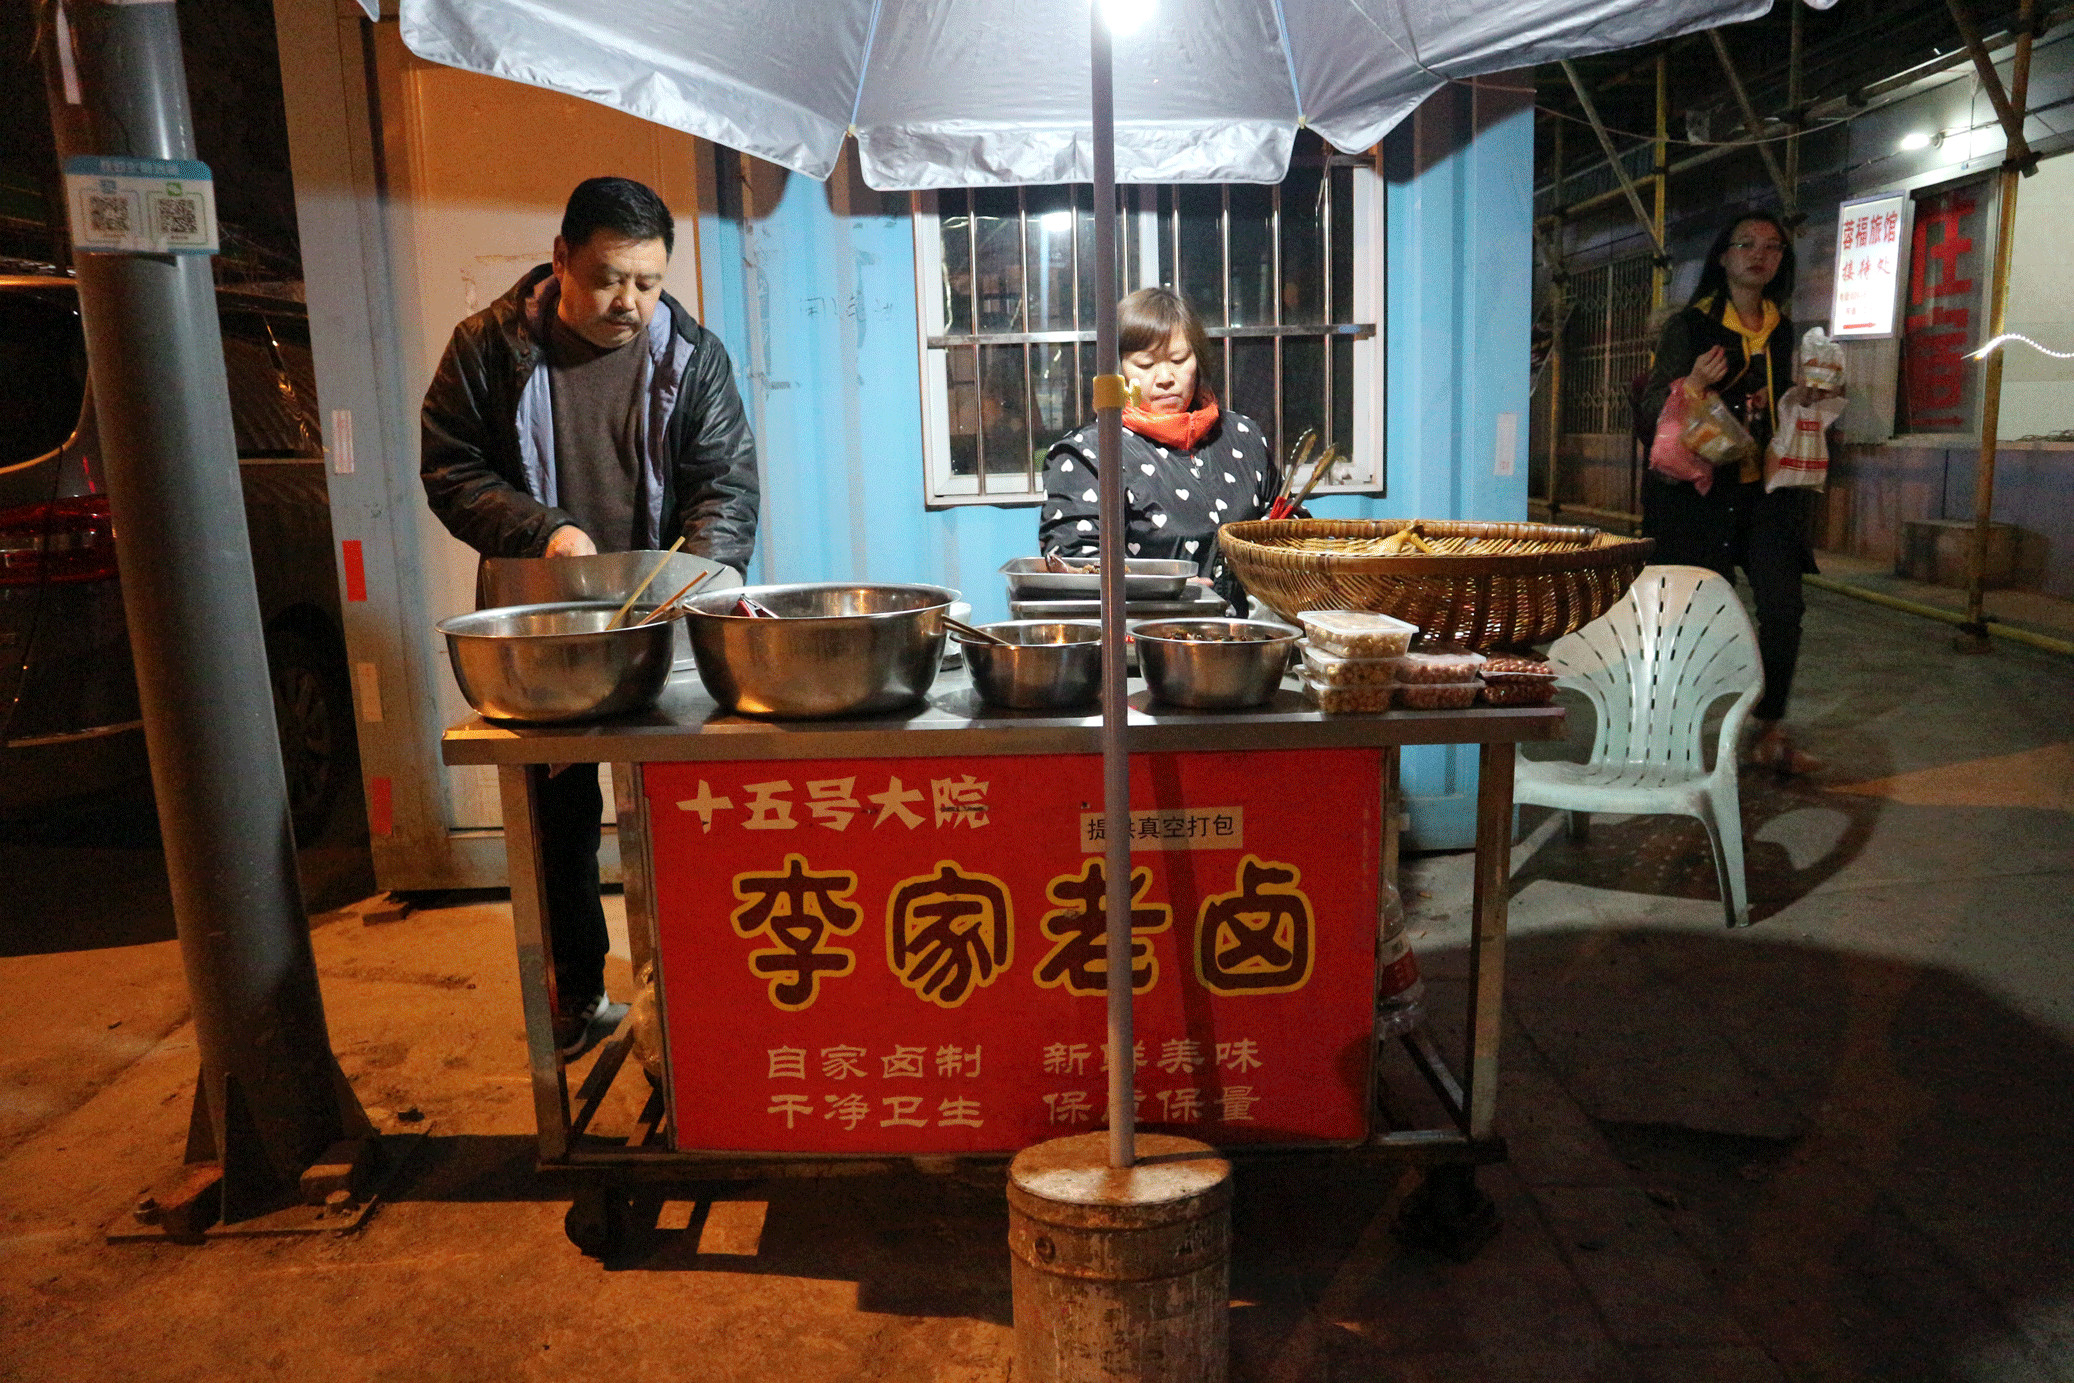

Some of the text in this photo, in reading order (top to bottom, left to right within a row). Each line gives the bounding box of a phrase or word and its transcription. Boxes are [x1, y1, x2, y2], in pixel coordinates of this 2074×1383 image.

[1841, 256, 1891, 282] 接待处
[676, 774, 991, 834] 十五号大院
[1087, 814, 1235, 841] 提真空打包
[730, 852, 1316, 1012] 李家老卤
[766, 1043, 983, 1080] 自家卤制
[766, 1093, 985, 1131] 干净卫生
